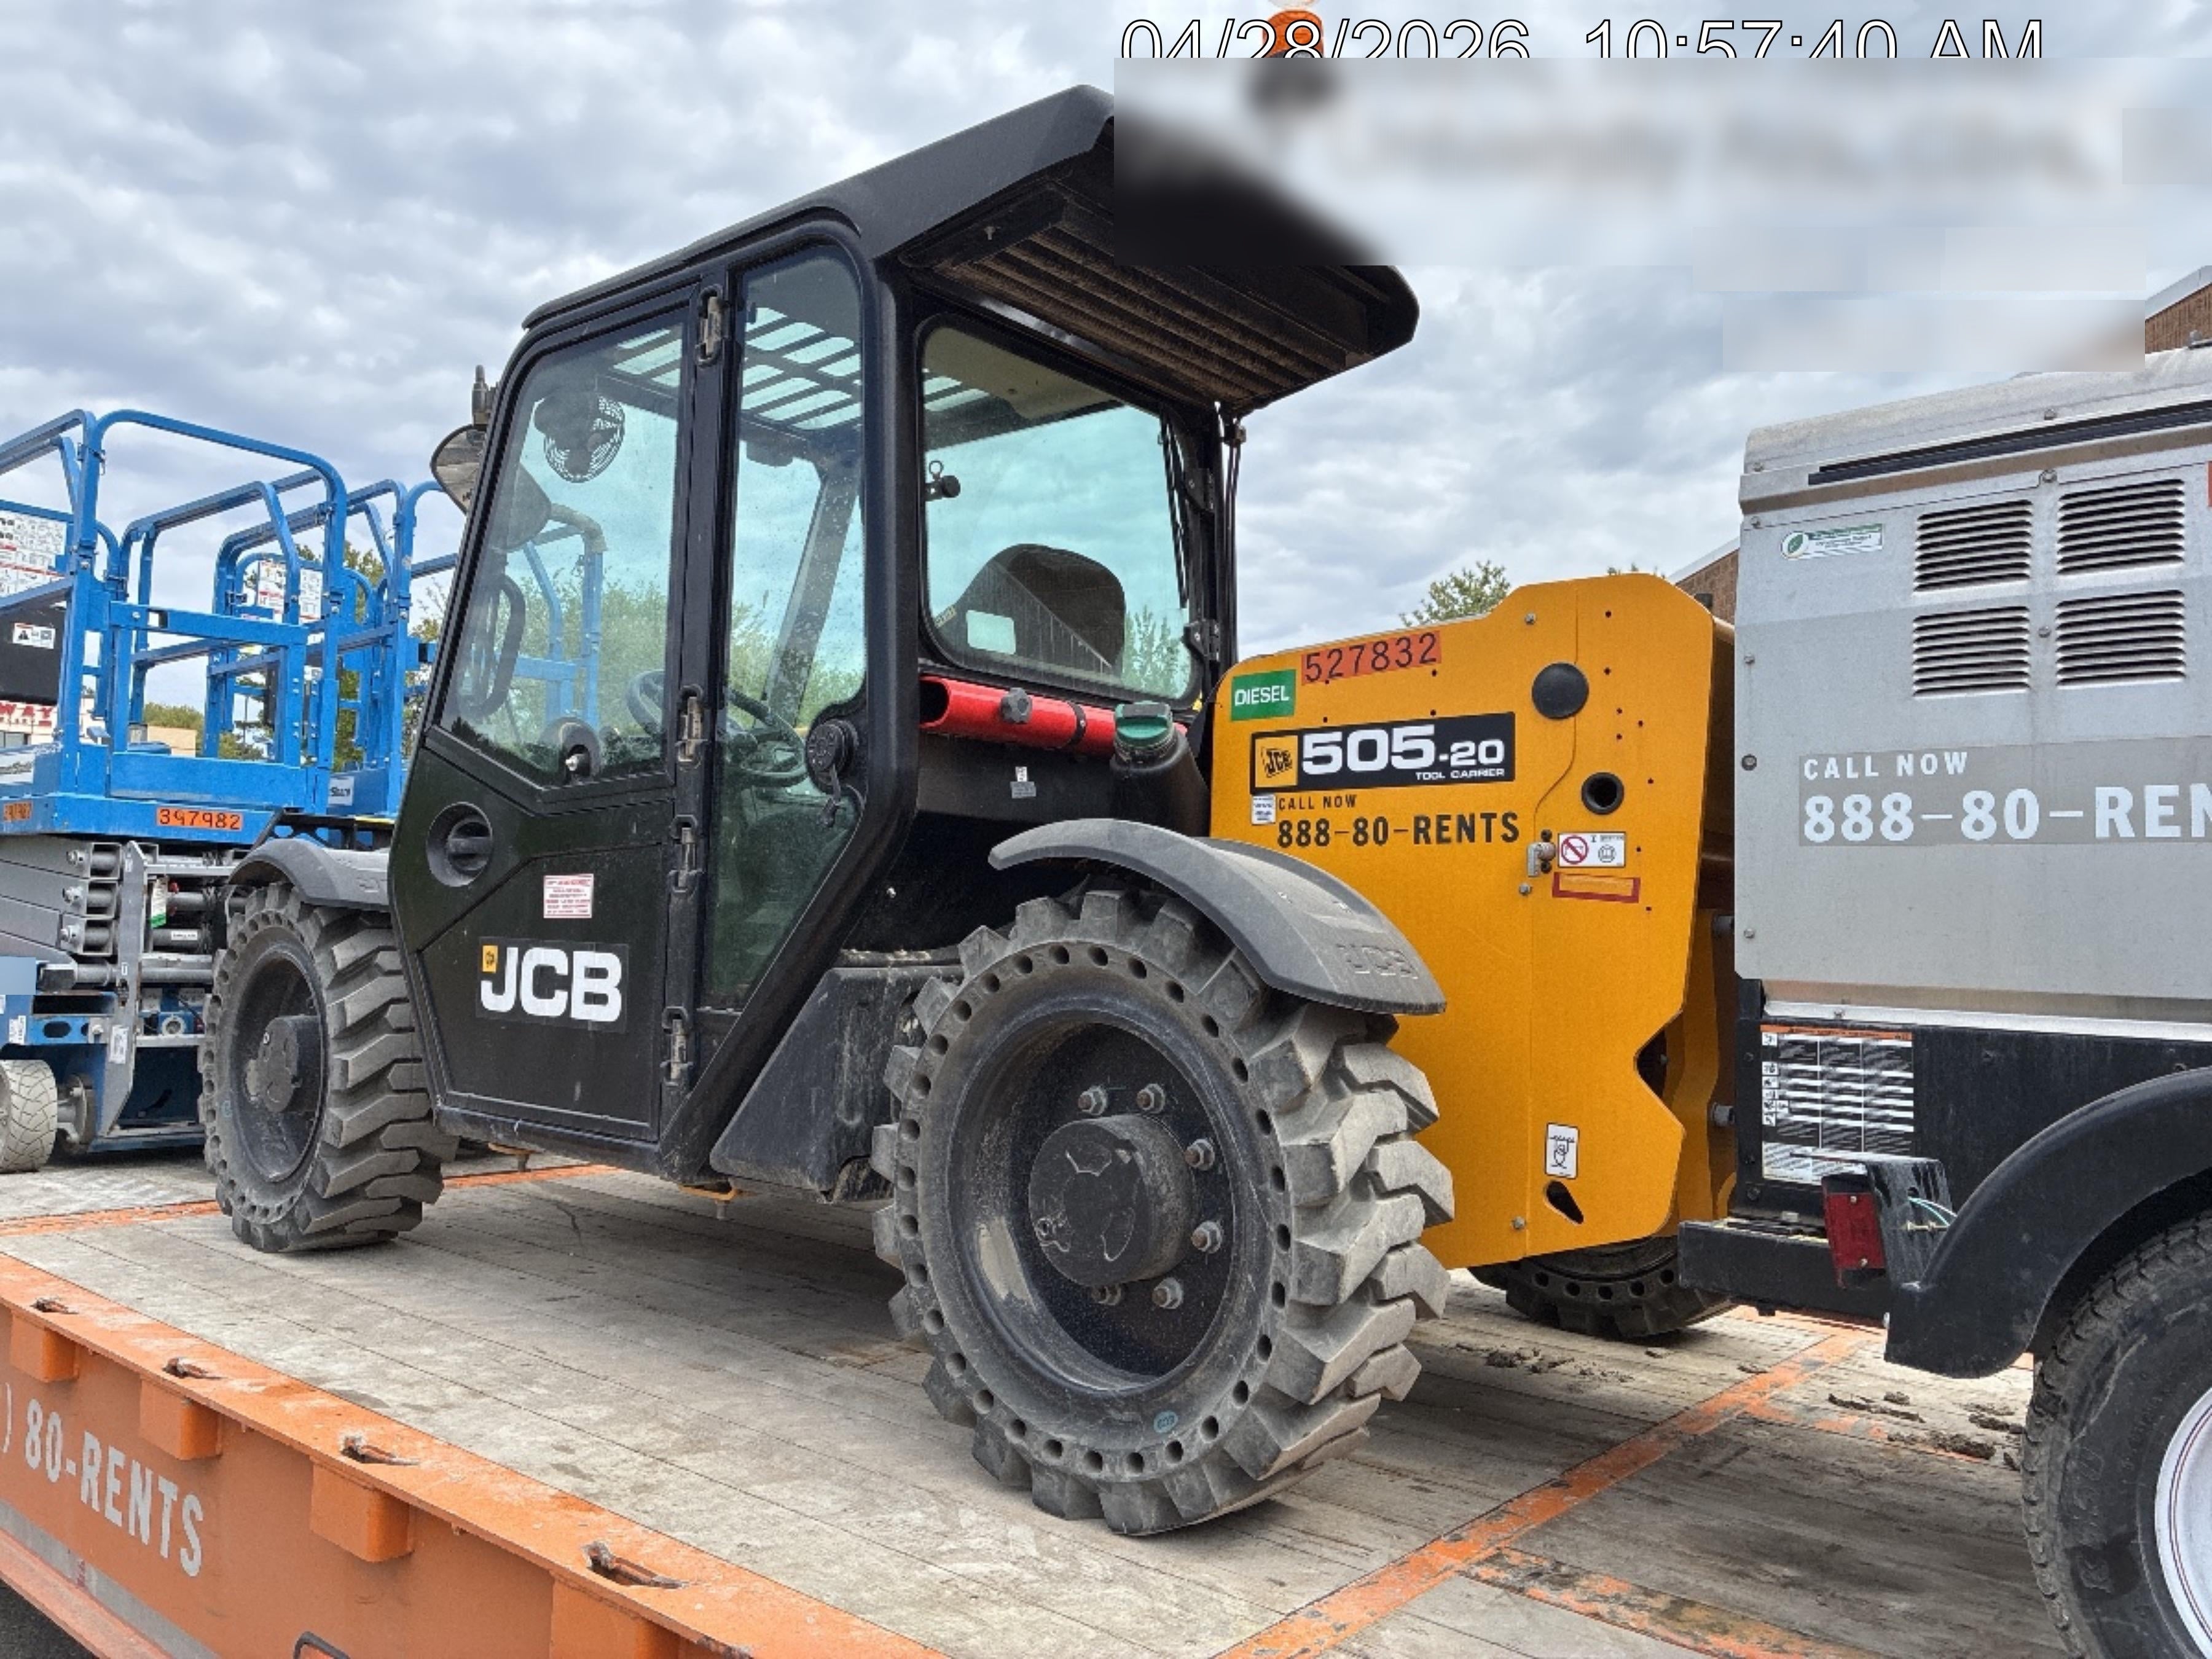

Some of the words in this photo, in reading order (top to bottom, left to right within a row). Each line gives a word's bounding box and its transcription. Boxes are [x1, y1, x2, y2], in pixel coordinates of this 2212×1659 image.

[1304, 632, 1437, 683] 527832
[1235, 685, 1290, 706] DIESEL
[1302, 724, 1505, 774] 505-20
[1804, 757, 1879, 780] CALL
[1897, 751, 1967, 777] NOW
[1416, 772, 1445, 780] TOOL
[1450, 768, 1504, 779] CARRIER
[1279, 797, 1315, 810] CALL
[1323, 794, 1356, 808] NOW
[1277, 812, 1520, 848] 888-80-RENTS
[480, 947, 622, 1022] JCB
[25, 1398, 203, 1577] 80-RENTS
